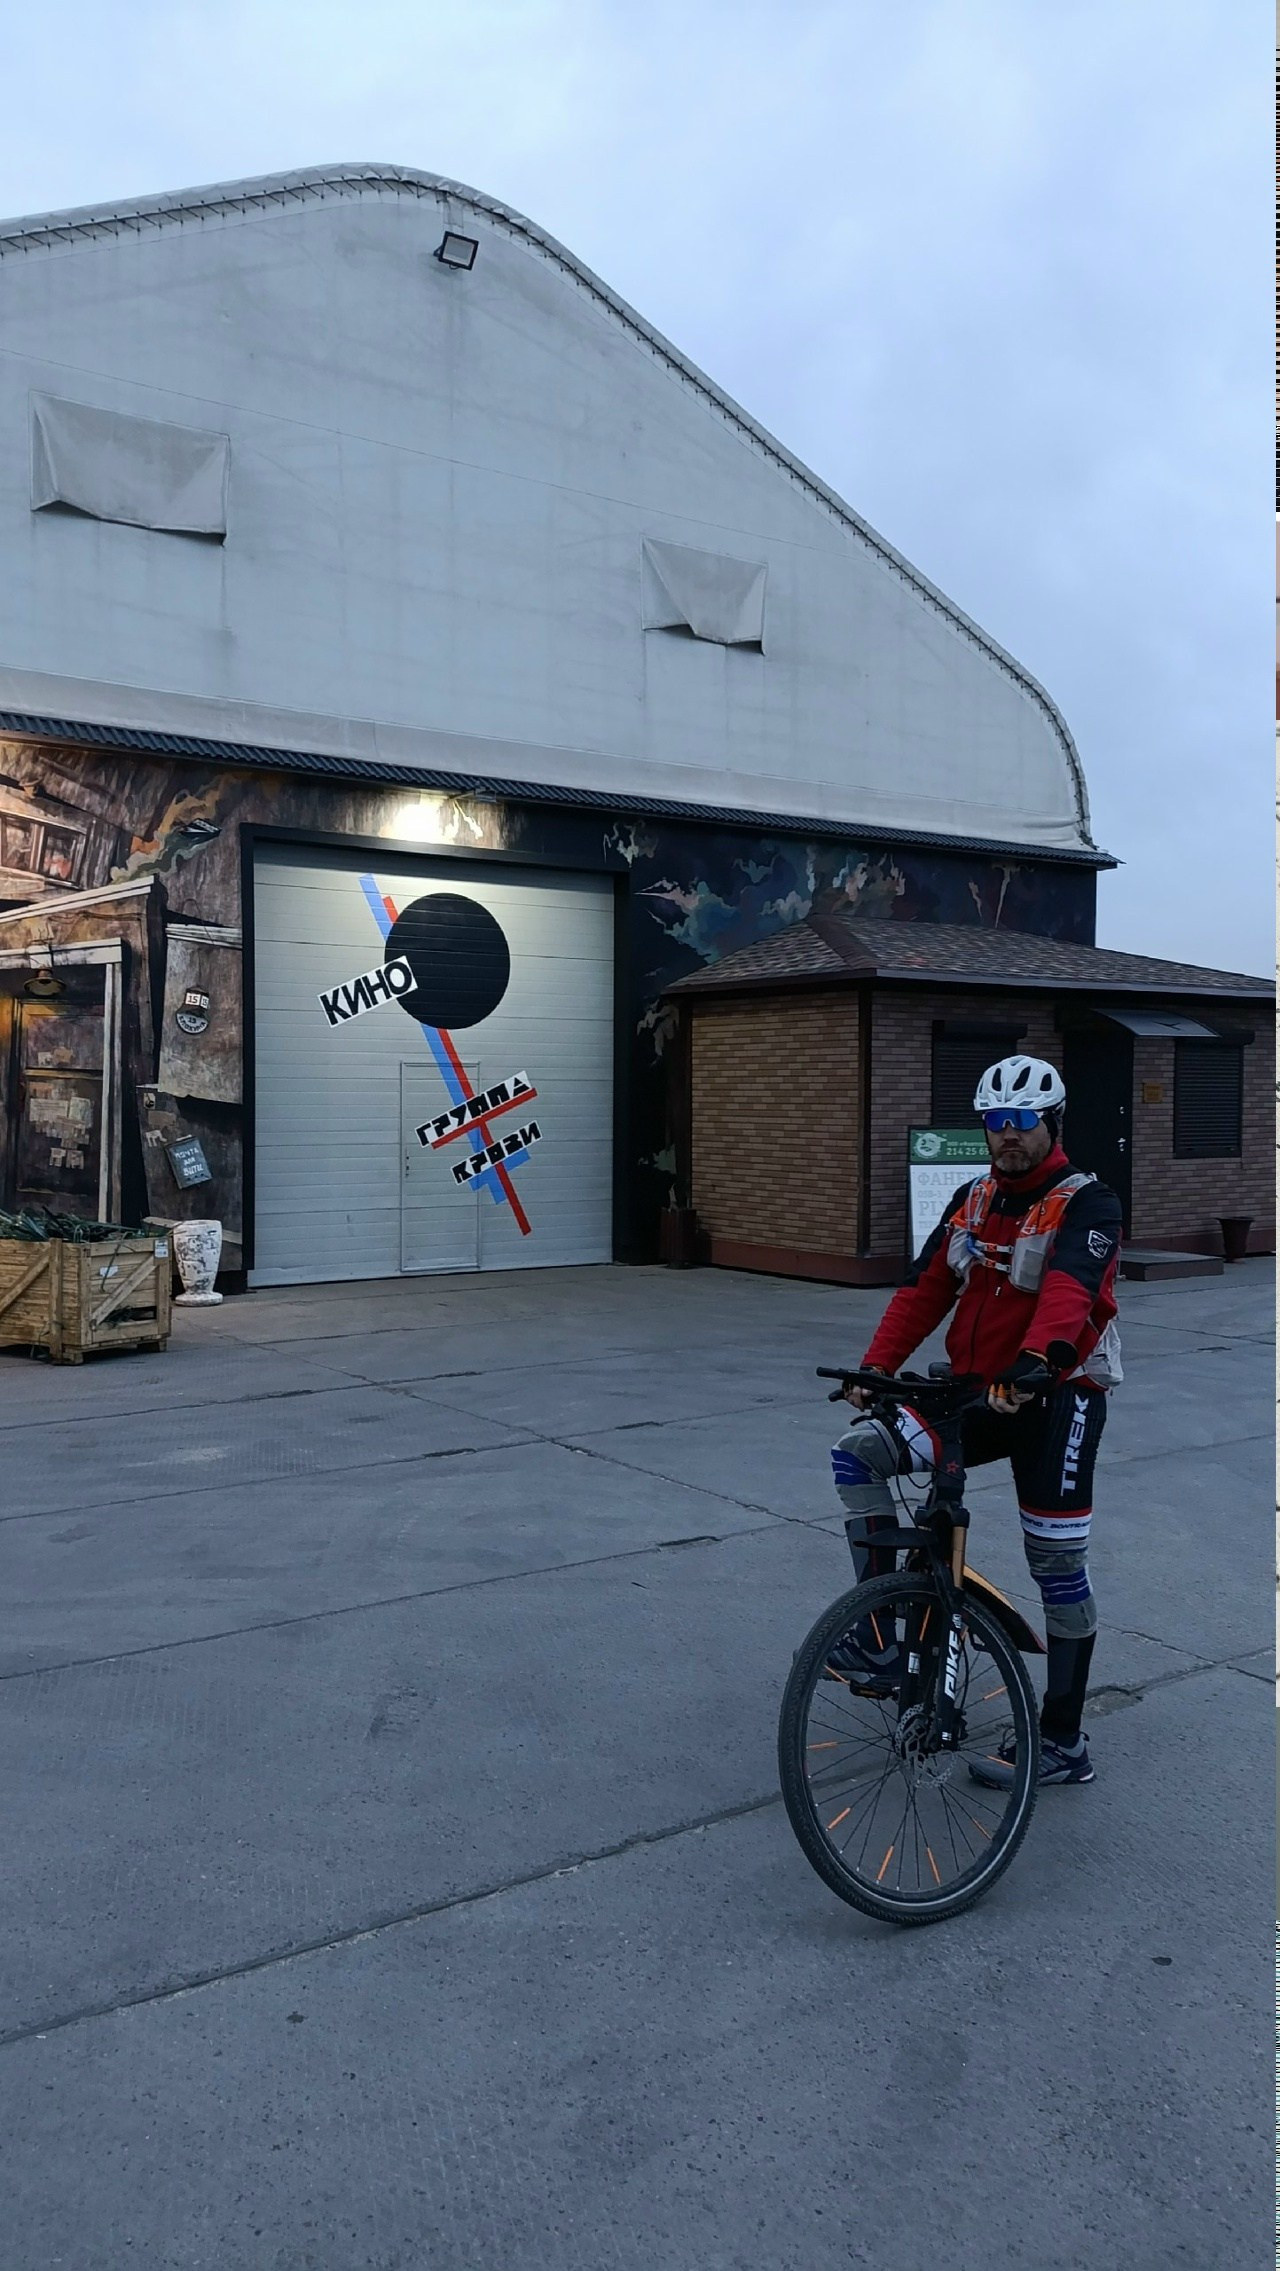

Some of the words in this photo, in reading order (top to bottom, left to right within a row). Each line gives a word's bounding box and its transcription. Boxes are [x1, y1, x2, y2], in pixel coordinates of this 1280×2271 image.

[319, 960, 413, 1026] КИНО
[415, 1076, 529, 1146] ГРУППА
[946, 1147, 963, 1156] 214
[965, 1147, 977, 1156] 25
[1060, 1393, 1089, 1497] TREK
[944, 1629, 960, 1701] PIKE
